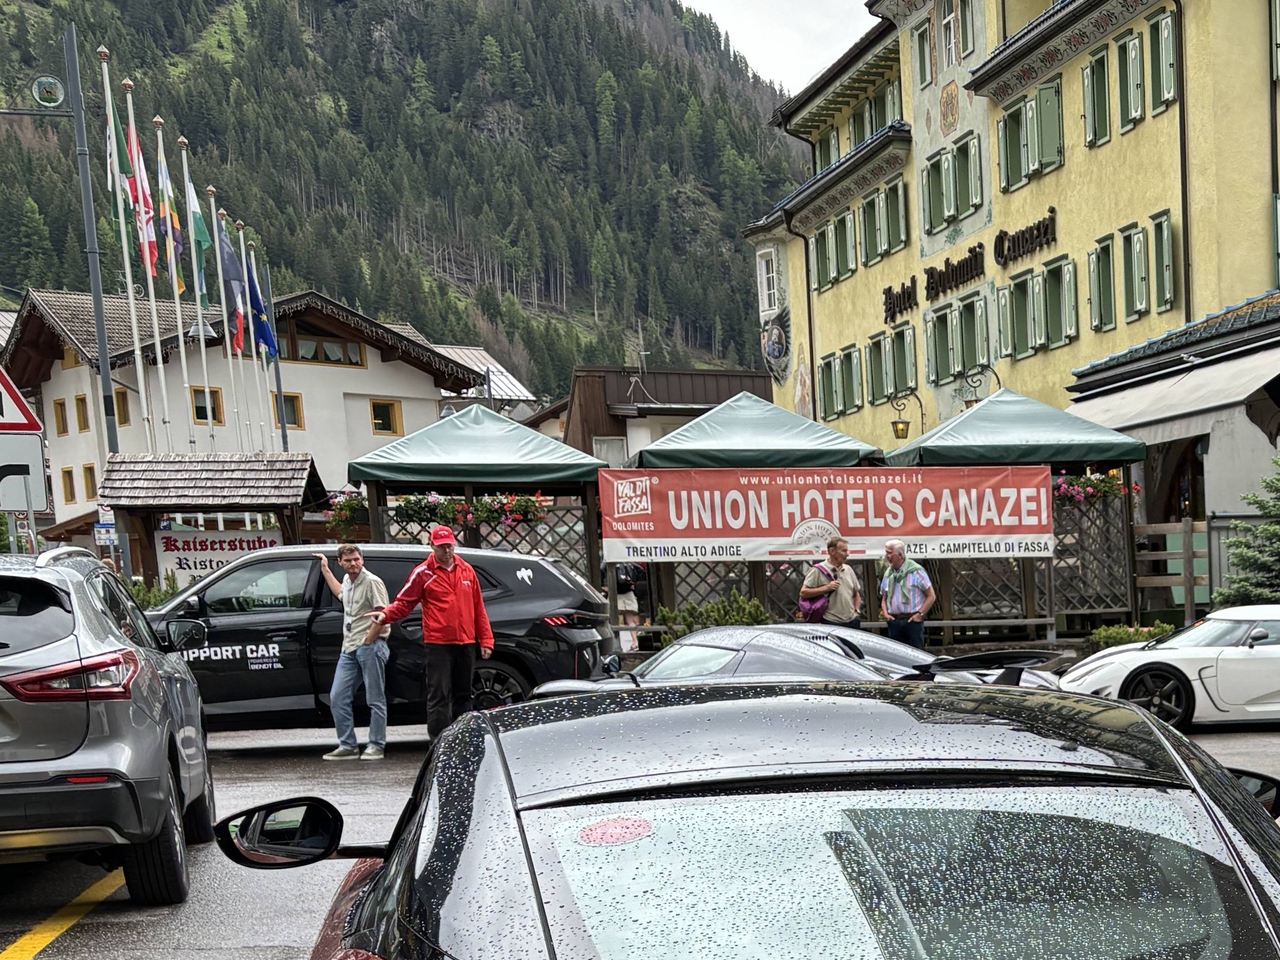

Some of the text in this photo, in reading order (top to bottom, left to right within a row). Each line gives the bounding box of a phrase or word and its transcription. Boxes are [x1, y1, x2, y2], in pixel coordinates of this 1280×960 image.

[883, 275, 918, 324] Hotel
[740, 473, 923, 485] www.unionhotelscanazei.it
[617, 482, 634, 497] VAL
[617, 496, 649, 512] FASSA
[668, 487, 1048, 530] UNION HOTELS CANAZEI
[613, 522, 655, 531] DOLOMITES
[161, 536, 278, 552] Kaiserstube
[625, 545, 742, 557] TRENTINO ALTO ADIGE
[906, 543, 928, 554] AZEI
[939, 542, 1001, 554] CAMPITELLO
[1004, 542, 1015, 552] DI
[1018, 541, 1050, 552] FASSA
[175, 557, 230, 570] Risto
[180, 644, 280, 661] UPPORT CAR
